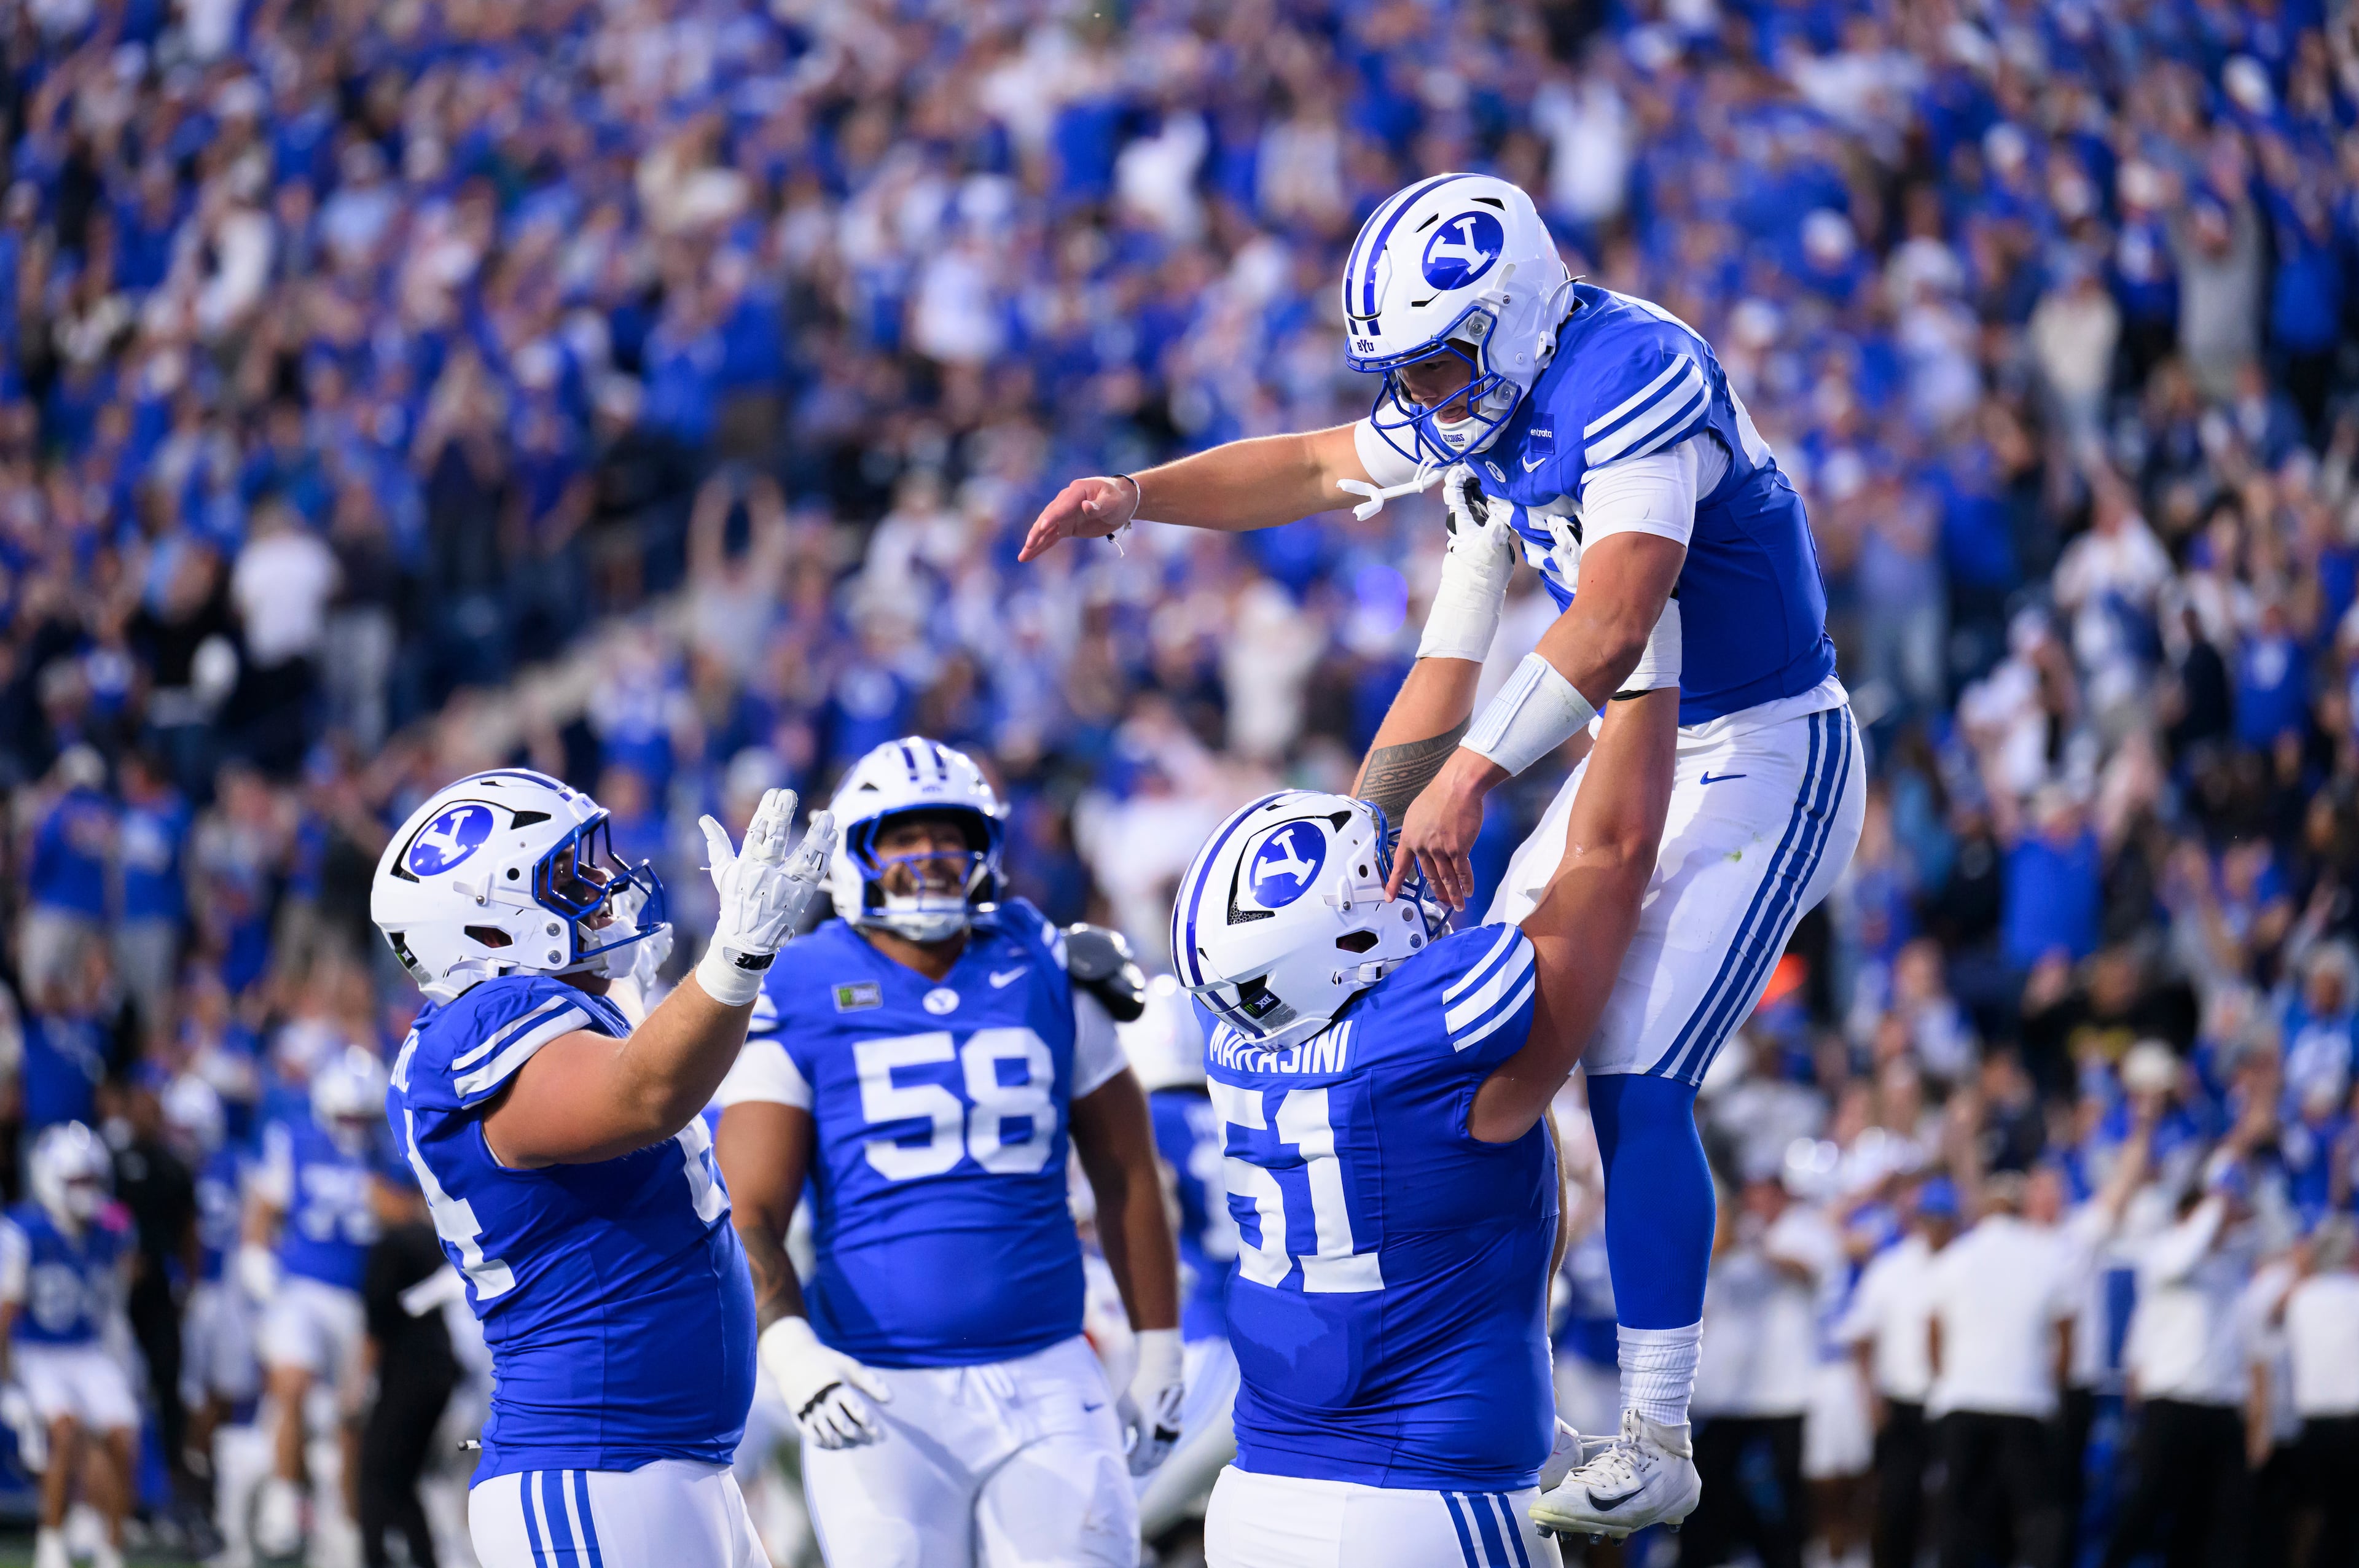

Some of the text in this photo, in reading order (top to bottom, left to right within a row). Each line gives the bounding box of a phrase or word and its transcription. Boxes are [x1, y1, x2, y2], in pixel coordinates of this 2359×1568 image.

[1427, 216, 1491, 276] Y
[1356, 339, 1375, 353] BYU
[1447, 433, 1465, 443] COUGS
[1530, 428, 1552, 439] entrata
[415, 809, 474, 866] Y
[1254, 828, 1316, 887] Y
[851, 1027, 1057, 1182] 58
[1207, 1074, 1386, 1293] 51
